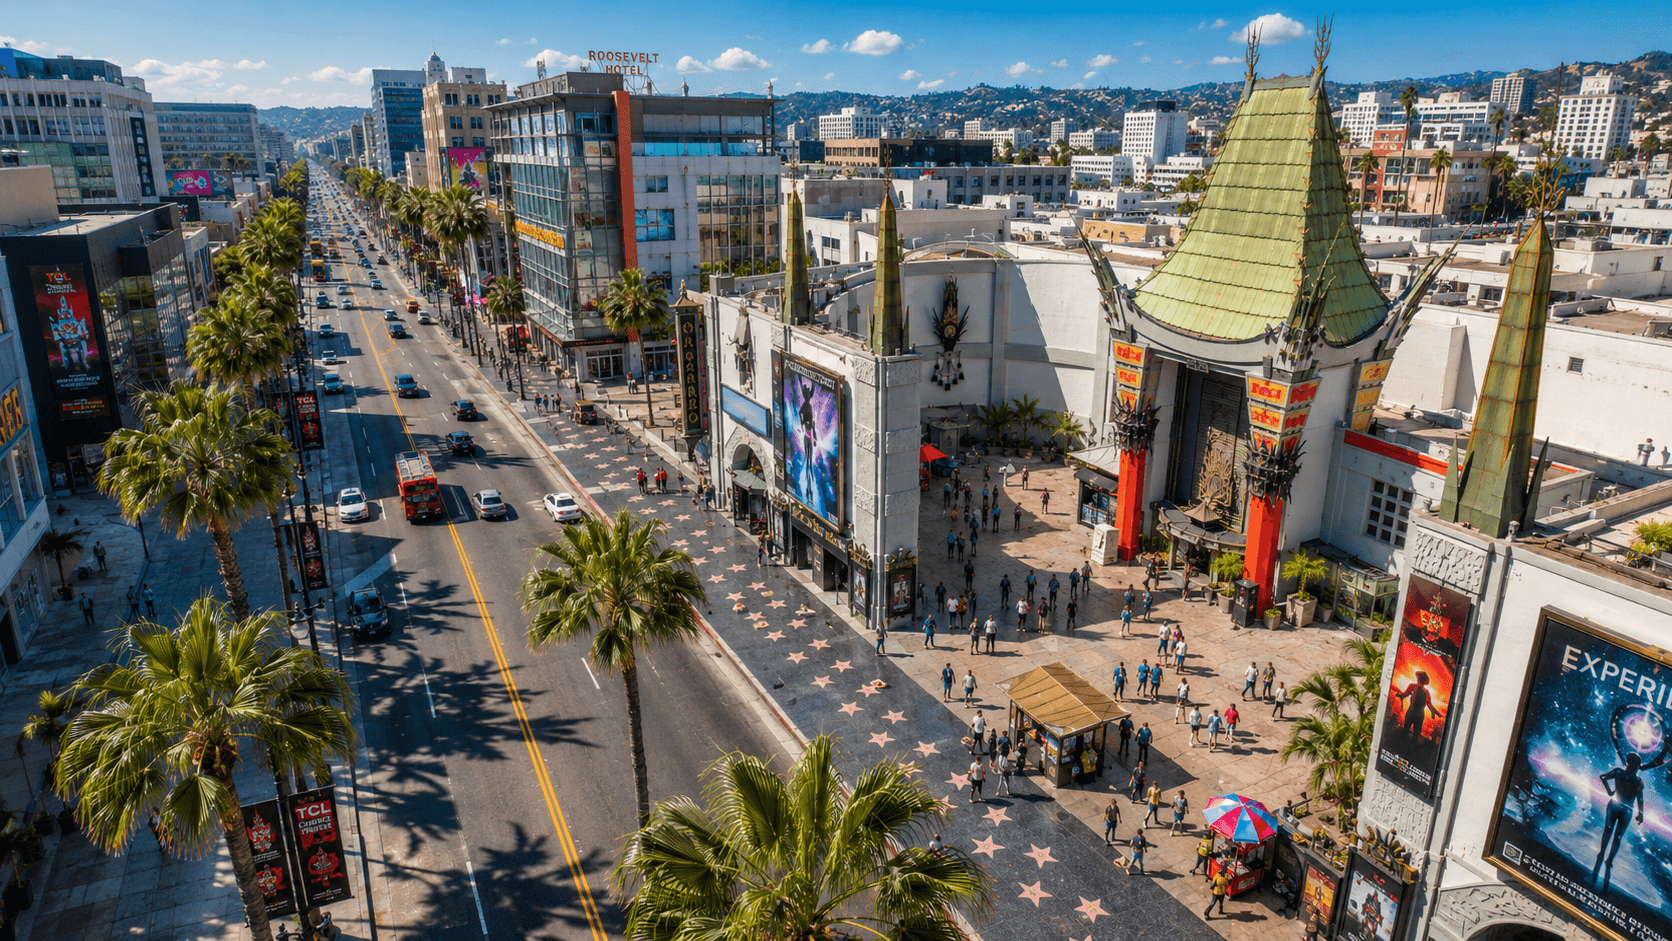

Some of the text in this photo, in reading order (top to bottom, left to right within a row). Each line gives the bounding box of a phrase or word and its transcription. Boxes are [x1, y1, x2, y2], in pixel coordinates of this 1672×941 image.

[588, 50, 660, 64] ROOSEVELT
[605, 64, 644, 76] HOTEL
[295, 396, 316, 404] TCL
[1560, 644, 1672, 711] EXPERI
[295, 802, 331, 819] TCL
